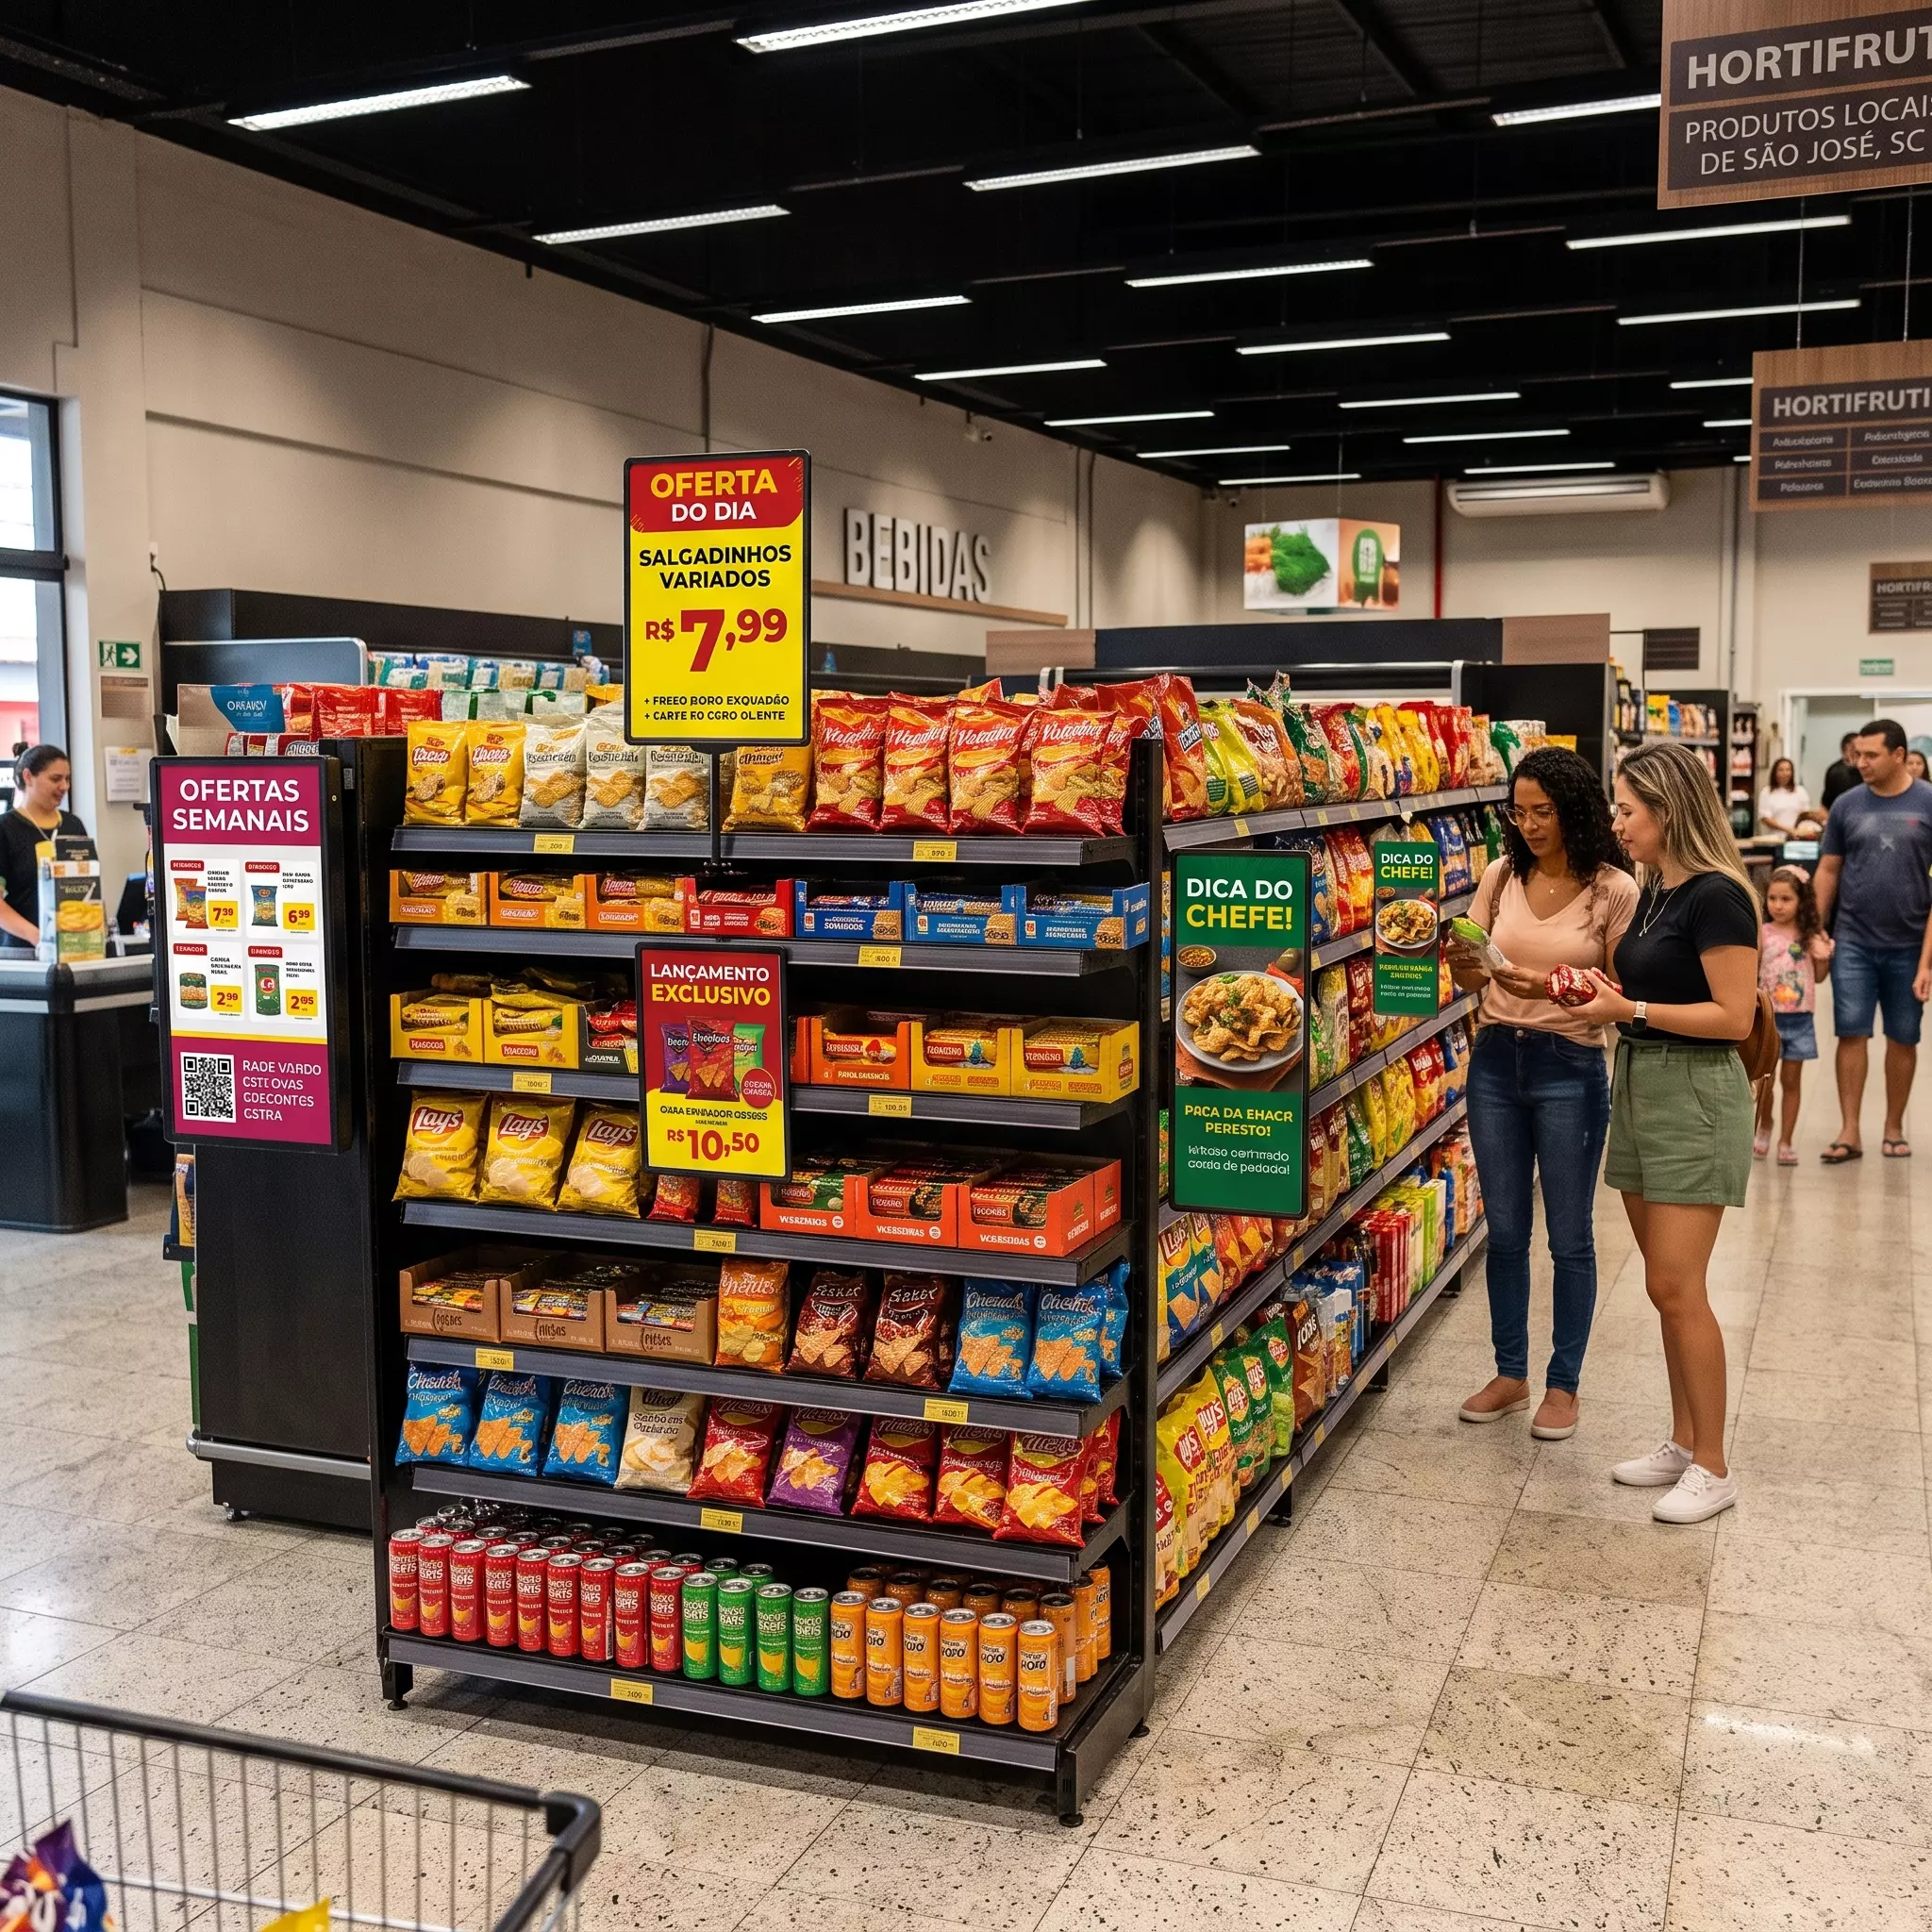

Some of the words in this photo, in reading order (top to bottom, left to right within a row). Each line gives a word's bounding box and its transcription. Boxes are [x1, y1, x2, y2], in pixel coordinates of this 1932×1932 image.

[1686, 106, 1835, 143] PRODUTOS
[1844, 94, 1932, 126] LOCAI
[1701, 151, 1735, 175] DE
[1743, 142, 1798, 170] SÃO
[1807, 130, 1881, 164] JOSÉ,
[1890, 129, 1924, 155] SC
[1773, 388, 1930, 417] HORTIFRUTI
[651, 469, 777, 498] OFERTA
[672, 504, 707, 521] DO
[714, 502, 757, 520] DIA
[640, 545, 791, 566] SALGADINHOS
[844, 508, 989, 603] BEBIDAS
[659, 570, 771, 589] VARIADOS
[645, 619, 675, 641] R$
[680, 608, 787, 672] 7,99
[741, 711, 785, 720] OLENTE
[179, 779, 300, 802] OFERTAS
[172, 808, 309, 833] SEMANAIS
[1381, 854, 1411, 864] DICA
[1415, 855, 1433, 864] DO
[1381, 866, 1432, 879] CHEFE!
[1187, 878, 1247, 899] DICA
[1256, 880, 1293, 900] DO
[1186, 905, 1292, 930] CHEFE!
[650, 964, 770, 982] LANÇAMENTO
[652, 984, 770, 1006] EXCLUSIVO
[272, 1078, 303, 1090] OVAS
[1224, 1108, 1242, 1119] DA
[1206, 1123, 1271, 1136] PERESTO!
[667, 1130, 684, 1142] R$
[687, 1130, 759, 1160] 10,50
[1224, 1160, 1238, 1171] de
